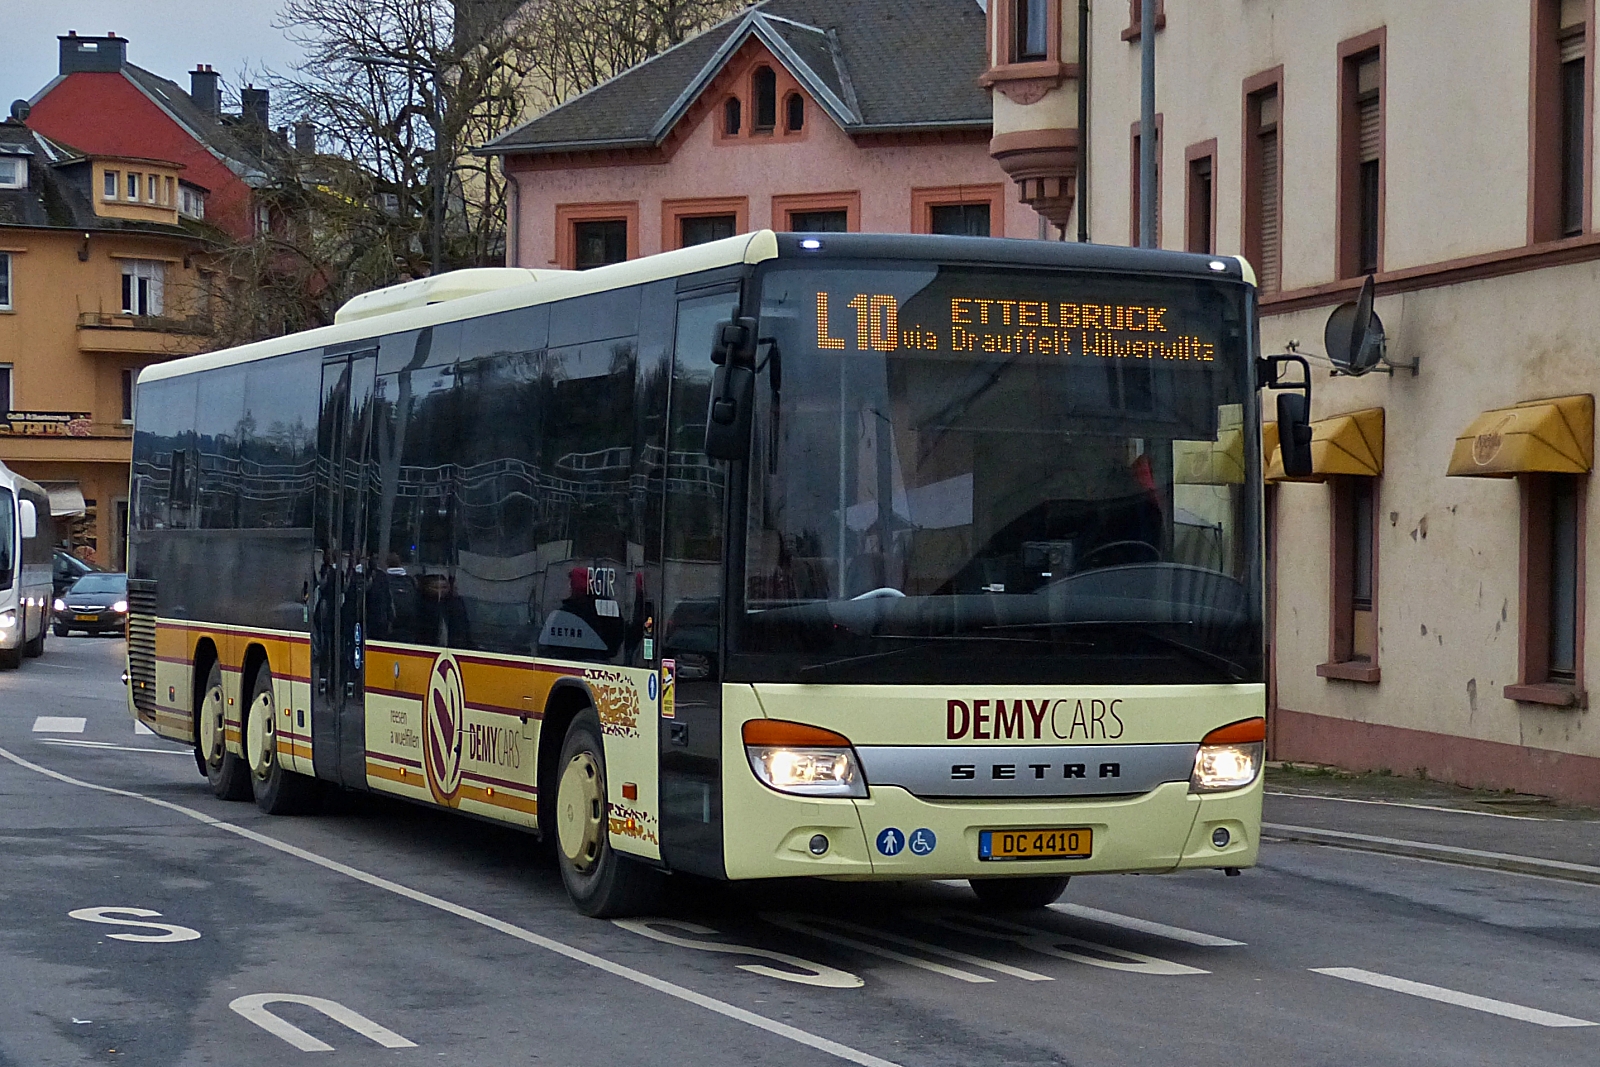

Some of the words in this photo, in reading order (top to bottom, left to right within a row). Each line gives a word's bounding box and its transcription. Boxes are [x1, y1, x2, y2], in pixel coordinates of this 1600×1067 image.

[951, 297, 1168, 333] ETTELBRUCK
[903, 324, 938, 351] via
[951, 325, 1073, 356] Drauffelt
[1082, 331, 1215, 362] Wilwerwiltz
[586, 566, 617, 597] RGTR
[550, 626, 583, 639] SETRA
[951, 762, 1121, 780] SETRA
[1003, 834, 1028, 853] DC
[1033, 832, 1079, 853] 4410
